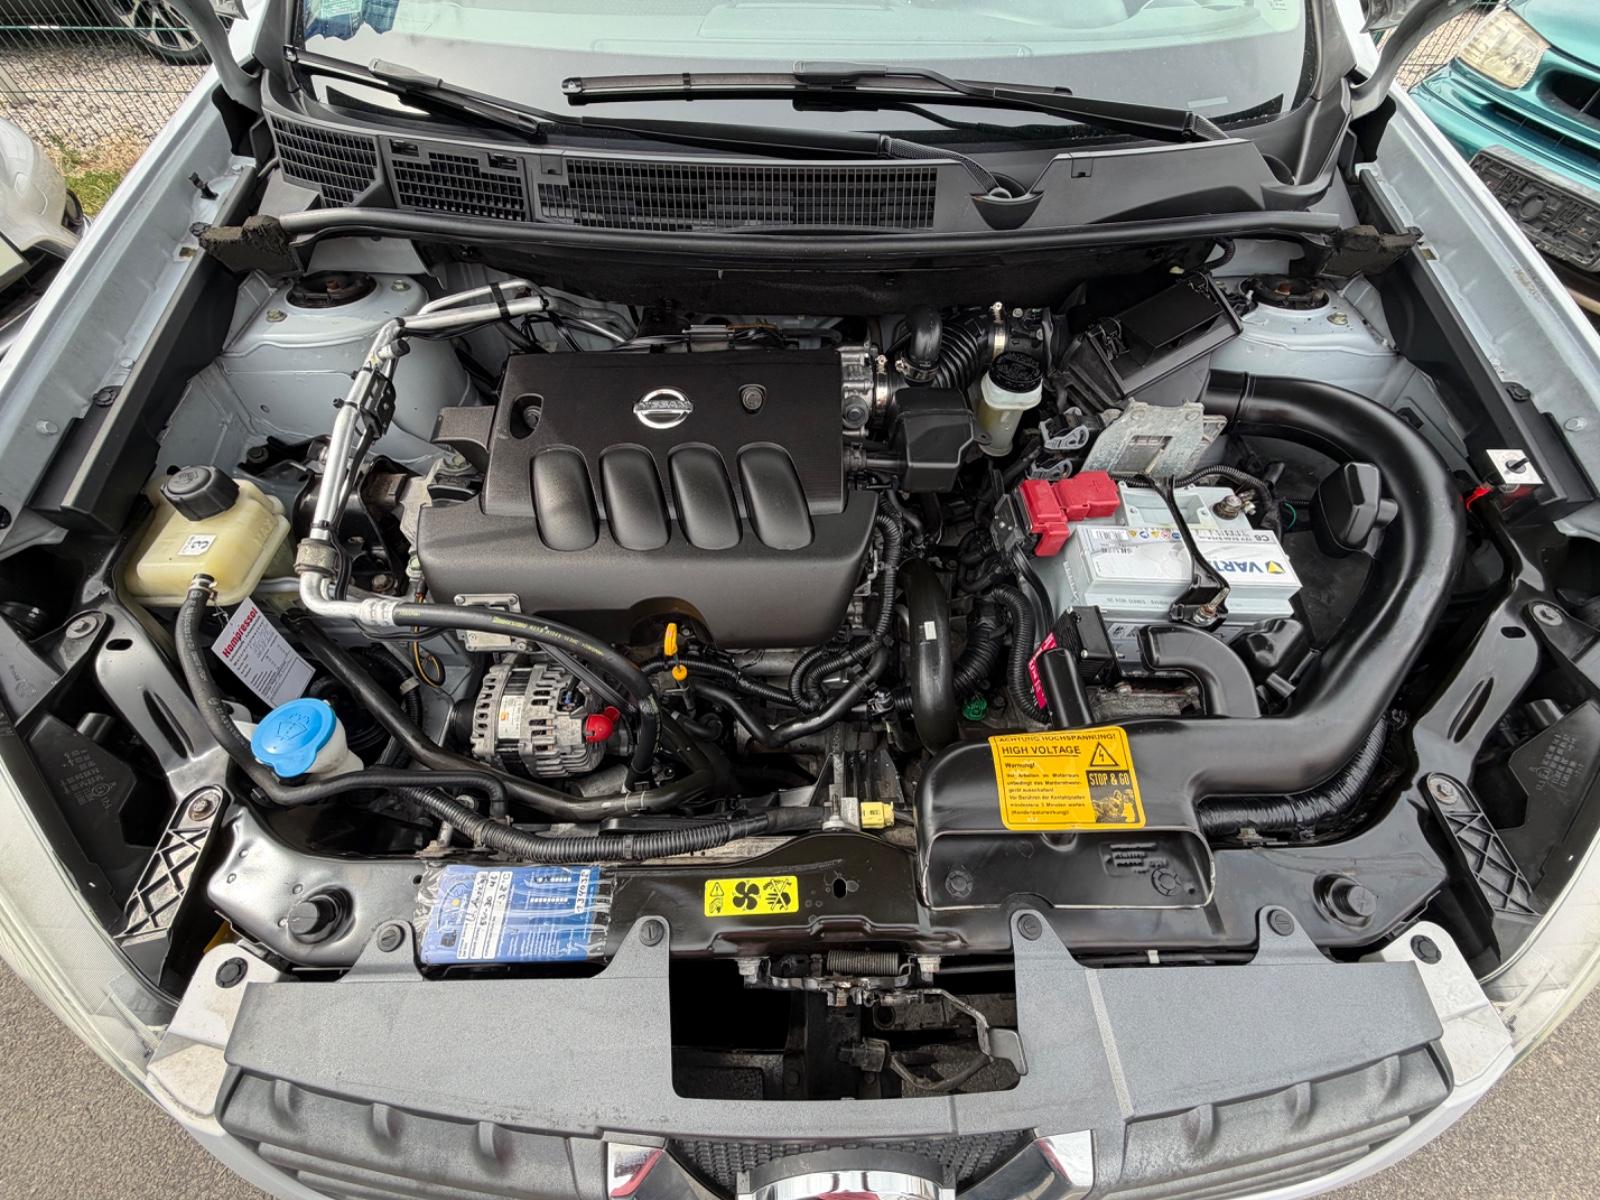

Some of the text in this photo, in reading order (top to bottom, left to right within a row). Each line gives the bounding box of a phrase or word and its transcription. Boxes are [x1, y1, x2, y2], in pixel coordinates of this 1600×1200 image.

[639, 400, 691, 410] NISSAN
[1210, 560, 1264, 573] VART
[1002, 745, 1082, 755] HIGH VOLTAGE
[1089, 773, 1130, 786] STOP & GO
